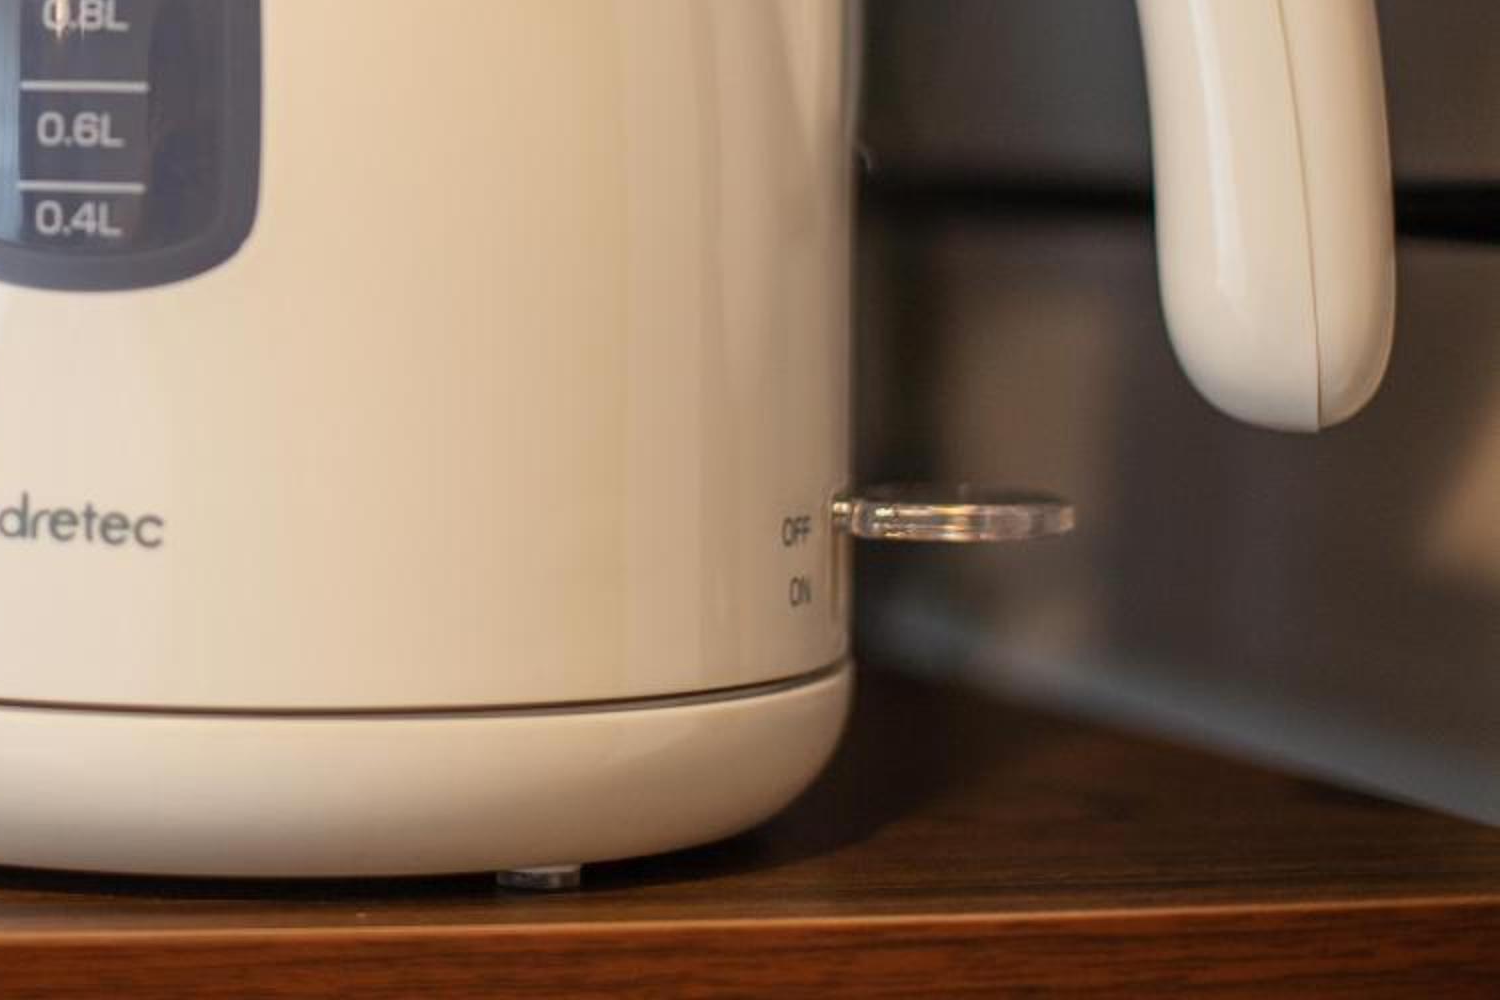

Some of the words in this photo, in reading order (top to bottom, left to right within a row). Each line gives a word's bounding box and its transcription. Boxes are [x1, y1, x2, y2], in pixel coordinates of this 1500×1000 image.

[36, 112, 124, 147] 0.6L
[34, 201, 121, 236] 0.4L
[782, 516, 810, 546] OFF
[790, 577, 811, 606] ON
